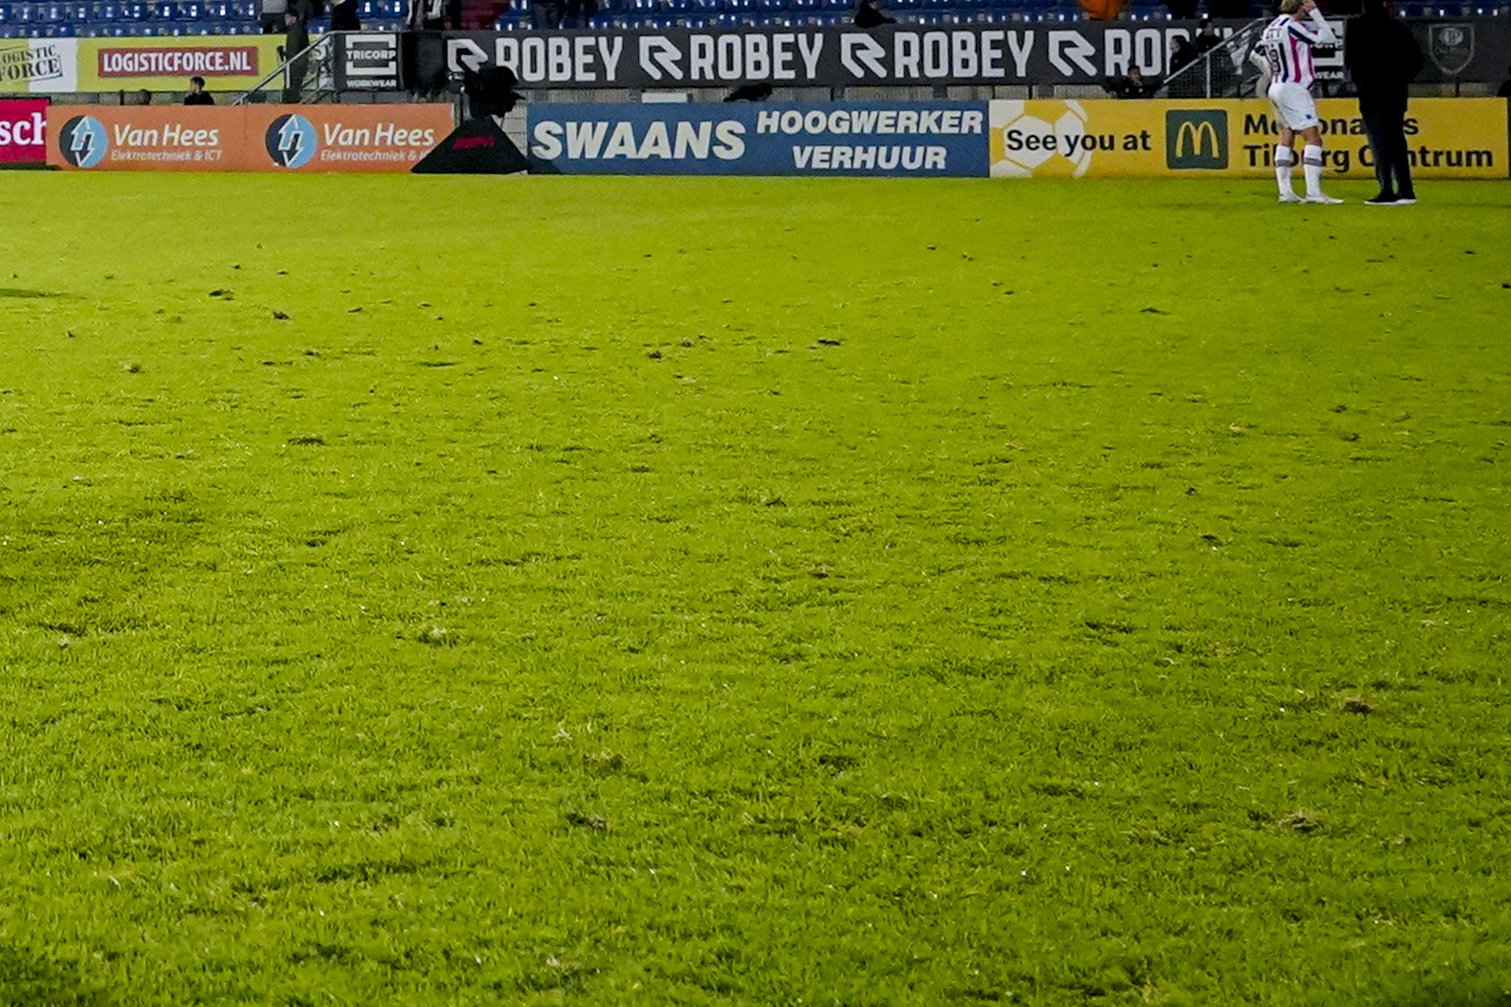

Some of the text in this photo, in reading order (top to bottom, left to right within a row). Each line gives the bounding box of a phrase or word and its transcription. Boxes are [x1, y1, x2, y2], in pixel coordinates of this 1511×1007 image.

[103, 51, 252, 72] LOGISTICFORCE.NL
[346, 50, 397, 60] TRICORP
[495, 36, 623, 81] ROBEY
[690, 33, 824, 80] ROBEY
[894, 30, 1034, 78] ROBEY
[346, 79, 397, 88] WORKWEAR
[757, 110, 983, 134] HOOGWERKER
[113, 123, 219, 146] Van Hees
[323, 124, 372, 146] Van
[374, 123, 434, 146] Hees
[531, 120, 746, 160] SWAANS
[1006, 129, 1152, 157] See you at
[110, 149, 191, 162] Elektrotechniek
[204, 150, 223, 161] ICT
[320, 148, 405, 162] Elektrotechniek
[792, 145, 947, 170] VERHUUR
